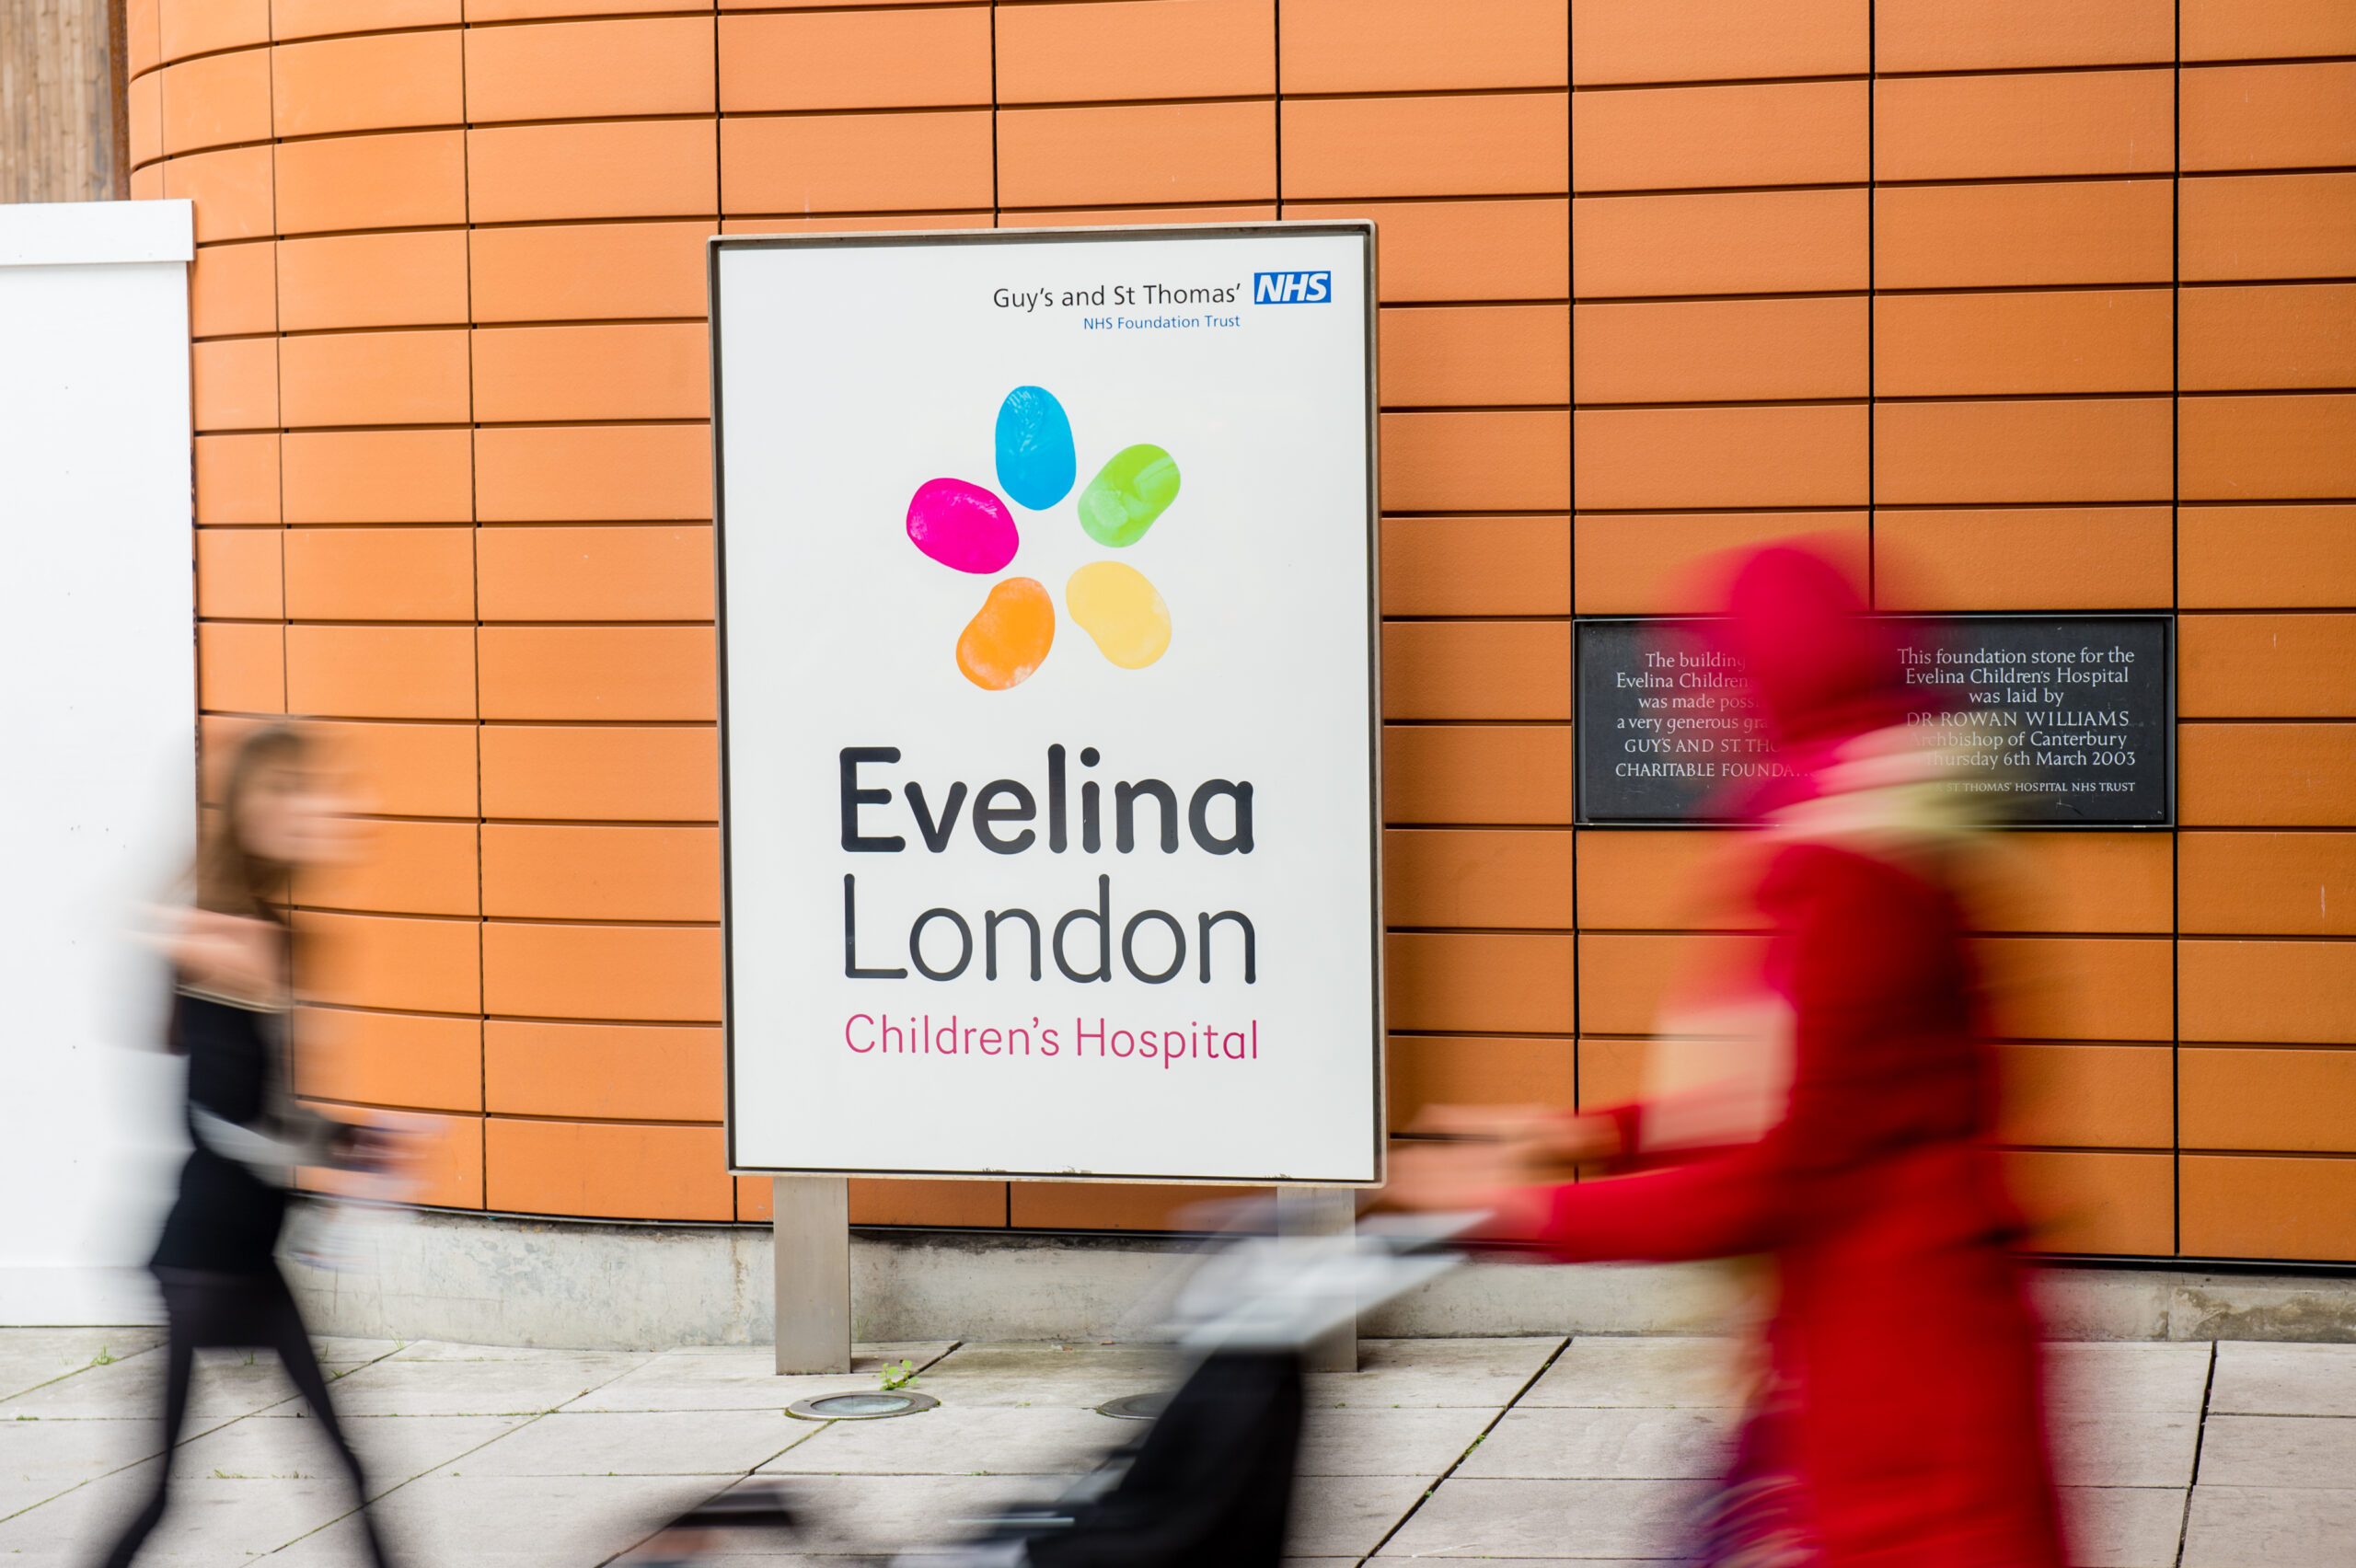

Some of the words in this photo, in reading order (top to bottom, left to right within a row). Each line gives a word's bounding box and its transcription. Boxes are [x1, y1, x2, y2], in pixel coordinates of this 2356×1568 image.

[1256, 273, 1327, 302] NHS
[993, 288, 1053, 313] Guy's
[1061, 285, 1104, 306] and
[1114, 285, 1135, 306] St
[1143, 283, 1241, 304] Thomas'
[1084, 317, 1113, 329] NHS
[1118, 316, 1200, 329] Foundation
[1205, 315, 1241, 328] Trust
[1646, 652, 1675, 668] The
[1680, 651, 1746, 672] building
[1897, 647, 1932, 664] This
[1935, 648, 2027, 664] foundation
[2031, 650, 2076, 663] stone
[2080, 647, 2104, 663] for
[2108, 645, 2135, 663] the
[1616, 672, 1673, 688] Evelina
[1906, 667, 1964, 684] Evelina
[1970, 667, 2050, 684] Children's
[2057, 666, 2129, 687] Hospital
[1638, 697, 1668, 709] was
[1672, 694, 1715, 709] made
[1969, 691, 2001, 703] was
[2006, 688, 2037, 703] laid
[2044, 688, 2064, 707] by
[1617, 718, 1625, 729] a
[1628, 718, 1663, 732] very
[1667, 717, 1739, 733] generous
[1744, 718, 1770, 733] gra
[1907, 712, 1934, 728] DR
[1941, 711, 2017, 727] ROWAN
[2026, 710, 2130, 727] WILLIAMS
[1624, 738, 1671, 753] GUY'S
[1676, 739, 1714, 753] AND
[2008, 731, 2025, 746] of
[2030, 731, 2128, 749] Canterbury
[2004, 751, 2030, 766] 6th
[2036, 751, 2086, 766] March
[2092, 751, 2135, 766] 2003
[1615, 763, 1715, 777] CHARITABLE
[2015, 782, 2068, 792] HOSPITAL
[2072, 782, 2096, 792] NHS
[2099, 782, 2135, 792] TRUST
[839, 744, 1254, 856] Evelina
[844, 873, 1256, 985] London
[845, 1013, 1059, 1056] Children's
[1077, 1017, 1257, 1069] Hospital
